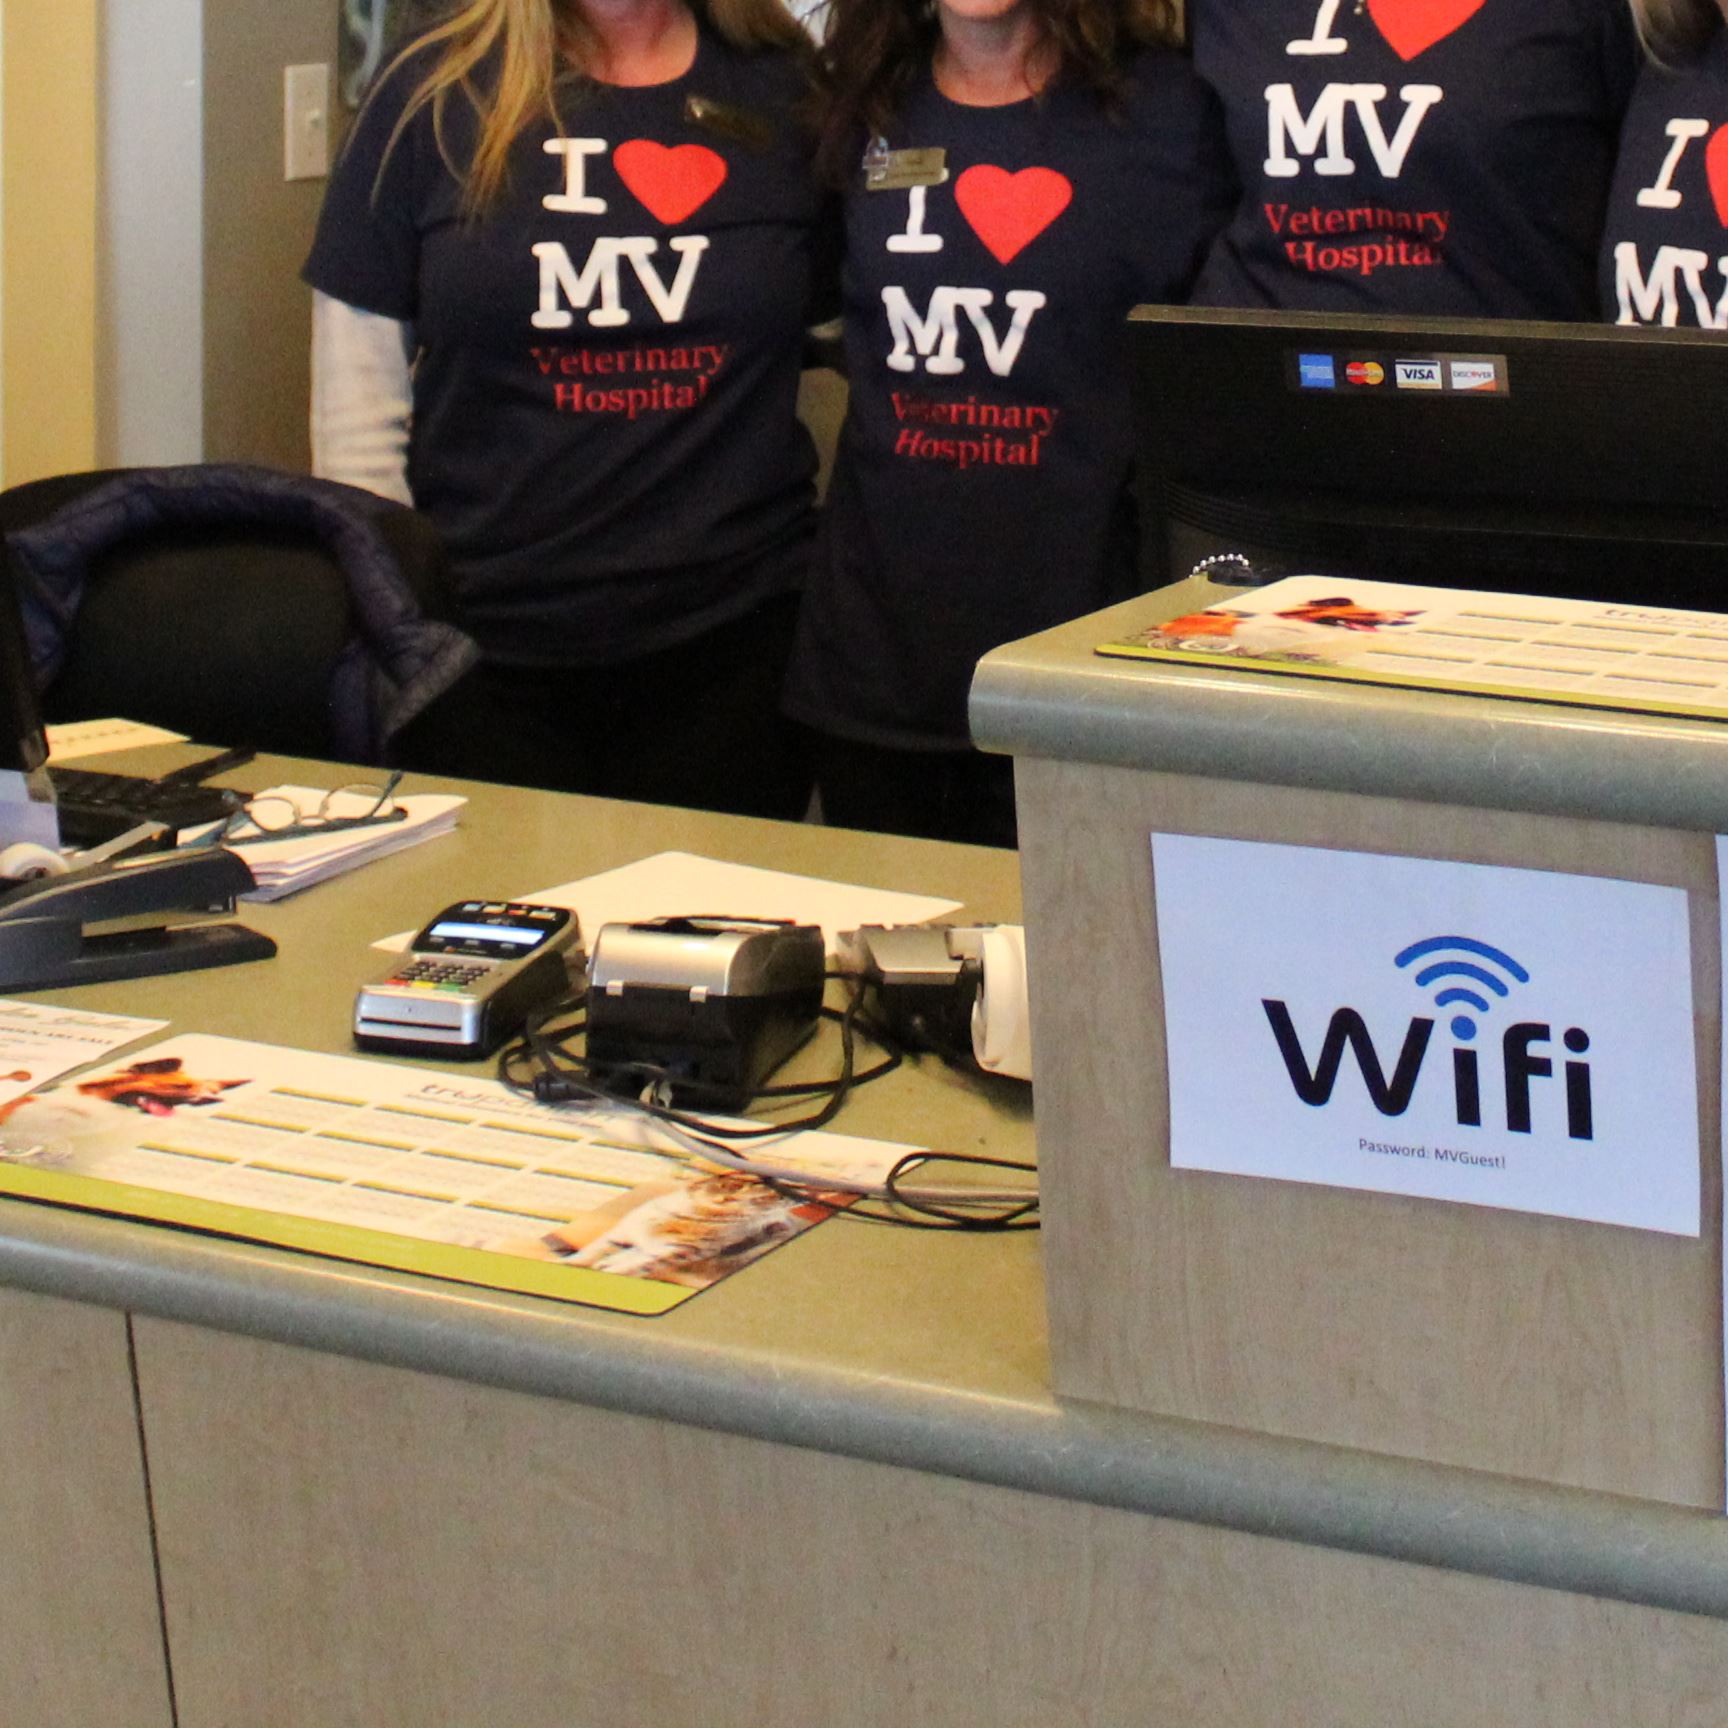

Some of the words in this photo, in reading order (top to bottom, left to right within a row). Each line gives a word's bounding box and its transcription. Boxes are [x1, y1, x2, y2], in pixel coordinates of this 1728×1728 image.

[1263, 83, 1443, 178] MV
[543, 137, 608, 215] I
[1636, 118, 1709, 209] I
[885, 184, 944, 253] I
[1263, 202, 1450, 242] Veterinary
[1284, 235, 1444, 276] Hospita
[530, 235, 709, 328] MV
[881, 286, 1046, 376] MV
[530, 344, 734, 375] Veterinary
[1402, 367, 1435, 380] VISA
[553, 375, 709, 420] Hospital
[890, 391, 1059, 438] Verinary
[894, 428, 1040, 469] Hospital
[1260, 997, 1593, 1141] Wifi
[1358, 1137, 1431, 1160] Password:
[1434, 1147, 1507, 1170] MVGuest!
